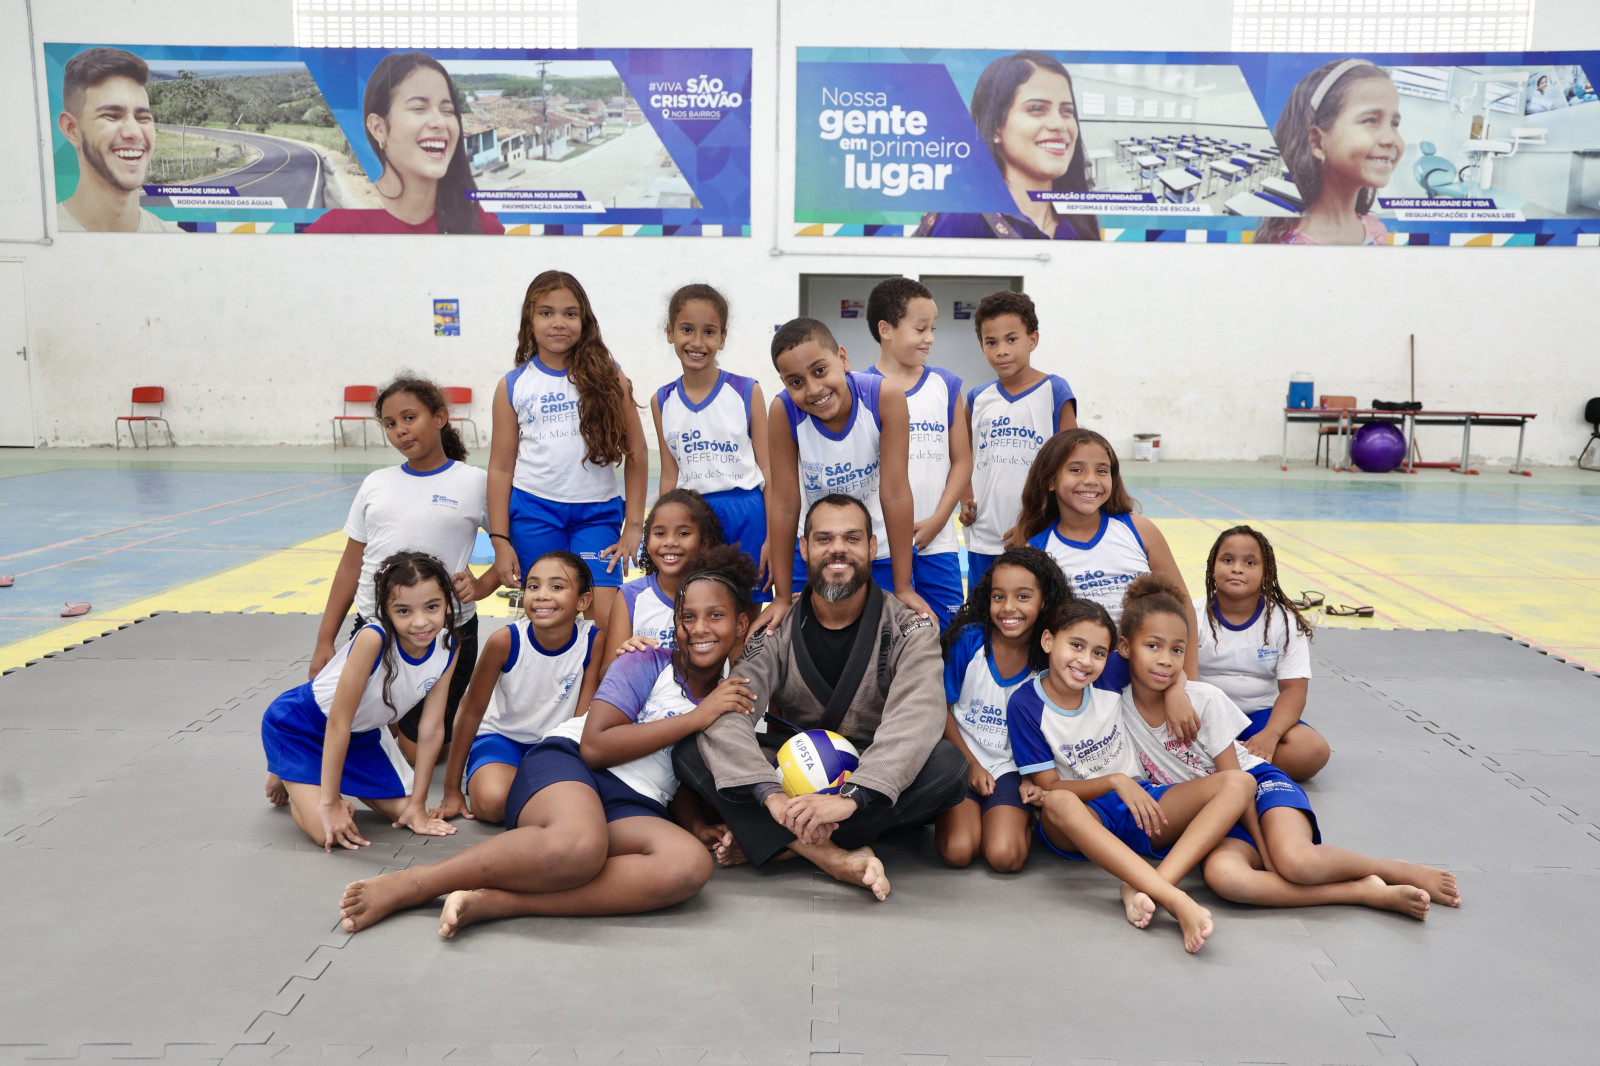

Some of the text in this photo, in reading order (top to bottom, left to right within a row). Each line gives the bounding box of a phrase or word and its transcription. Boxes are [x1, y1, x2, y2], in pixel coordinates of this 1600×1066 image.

[649, 75, 723, 93] #VIVA SÃO
[651, 91, 742, 108] CRISTÓVÃO
[822, 86, 887, 107] Nossa
[819, 105, 928, 140] gente
[839, 136, 971, 161] em primeiro
[845, 154, 952, 197] lugar
[208, 198, 235, 206] PARAÍSO
[1042, 192, 1079, 200] EDUCAÇÃO
[1086, 193, 1143, 201] OPORTUNIDADES
[1109, 204, 1158, 212] CONSTRUÇÕES
[1405, 211, 1468, 219] REQUALIFICAÇÕES
[540, 392, 566, 403] SÃO
[825, 462, 851, 476] SÃO
[1075, 570, 1104, 583] SÃO
[982, 704, 1002, 716] SÃO
[1075, 739, 1093, 752] SÃO
[795, 738, 815, 771] KIPSTA
